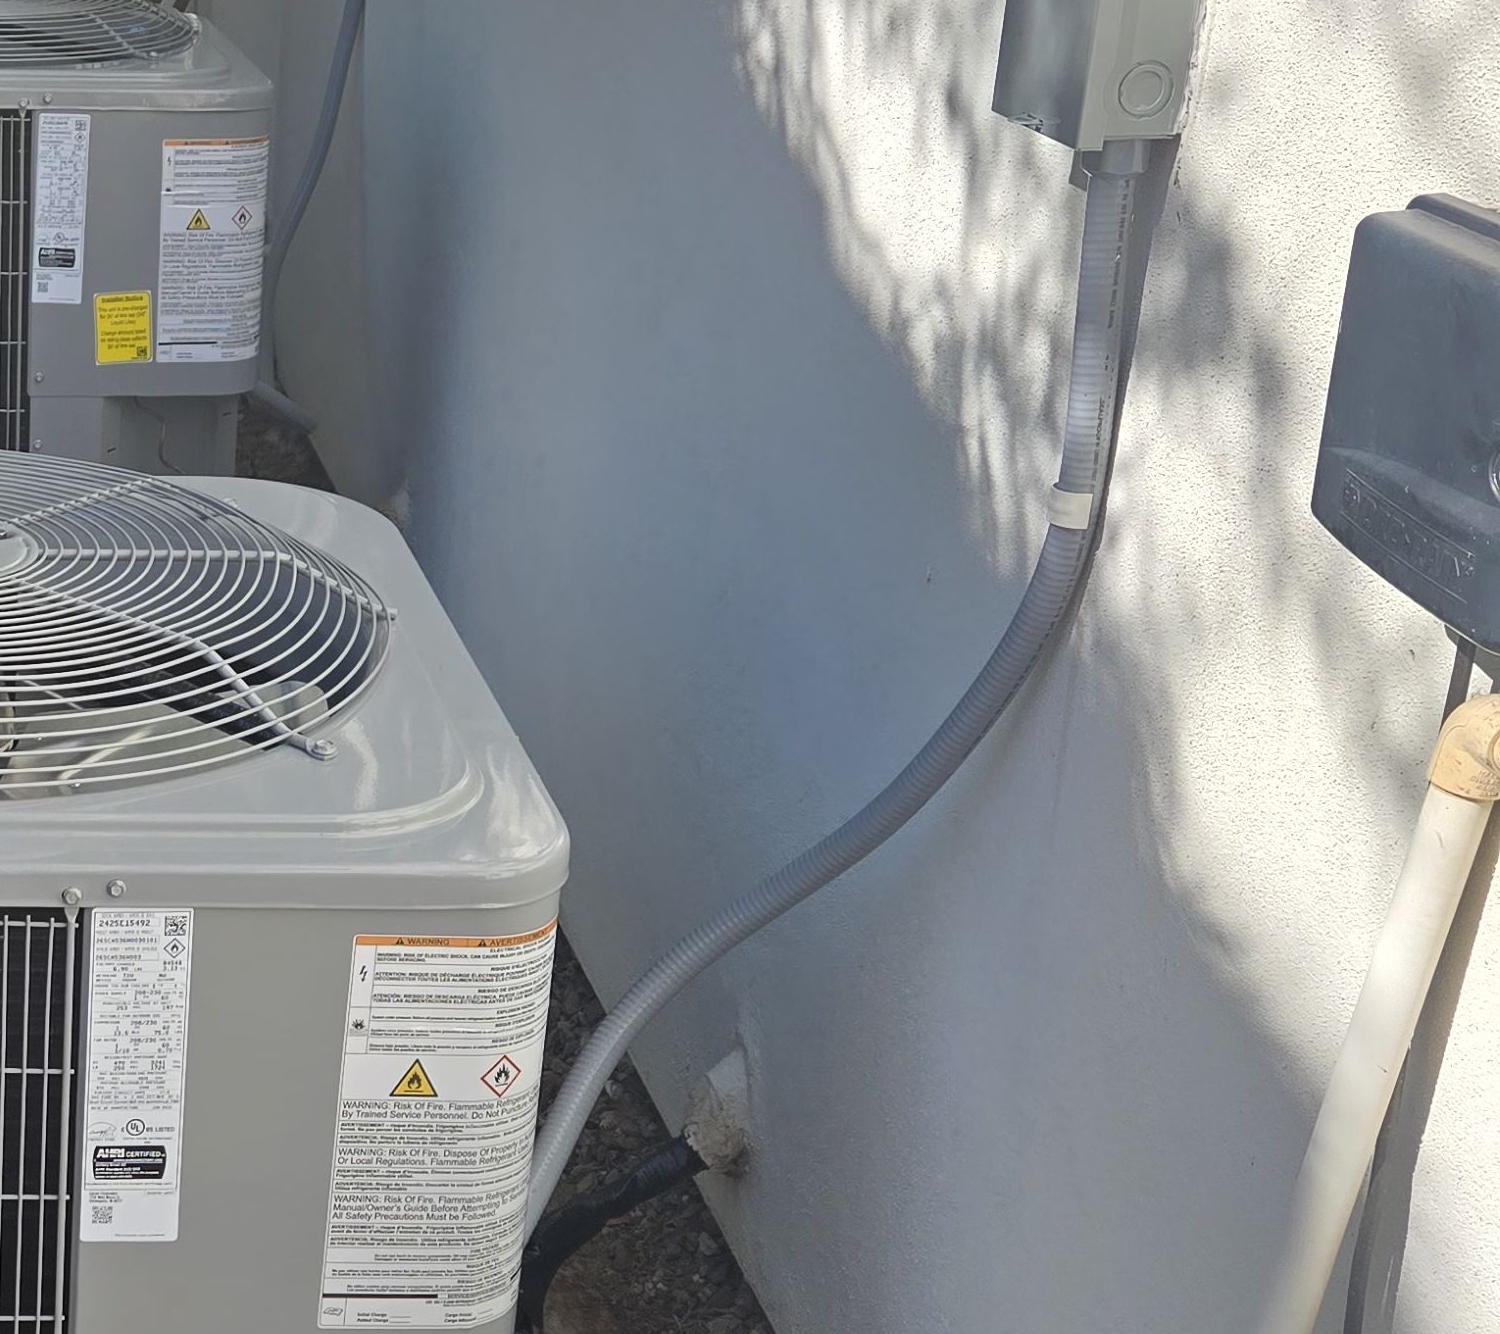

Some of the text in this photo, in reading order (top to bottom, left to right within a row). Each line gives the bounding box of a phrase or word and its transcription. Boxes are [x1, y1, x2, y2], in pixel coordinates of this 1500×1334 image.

[407, 938, 450, 946] WARNING
[342, 1101, 391, 1110] WARNING:
[393, 1101, 412, 1110] Risk
[414, 1102, 426, 1110] Of
[427, 1102, 446, 1111] Fire.
[448, 1102, 495, 1111] Flammable
[342, 1110, 353, 1119] By
[356, 1110, 388, 1118] Trained
[390, 1111, 421, 1119] Service
[423, 1112, 469, 1120] Personnel.
[485, 1110, 500, 1118] Not
[338, 1148, 387, 1156] WARNING:
[388, 1148, 408, 1156] Risk
[409, 1148, 420, 1156] Of
[422, 1149, 440, 1157] Fire.
[443, 1149, 478, 1159] Dispose
[479, 1148, 490, 1157] Of
[337, 1156, 348, 1164] Or
[350, 1157, 374, 1165] Local
[375, 1157, 426, 1167] Regulations.
[430, 1158, 477, 1166] Flammable
[334, 1195, 382, 1203] WARNING:
[384, 1195, 402, 1203] Risk
[404, 1195, 416, 1203] Of
[417, 1196, 435, 1204] Fire.
[438, 1196, 483, 1204] Flammable
[333, 1203, 401, 1212] Manual/Owner's
[403, 1204, 429, 1212] Guide
[460, 1200, 500, 1212] Attempting
[332, 1209, 497, 1221] All Safety Precautions Must be Followed.
